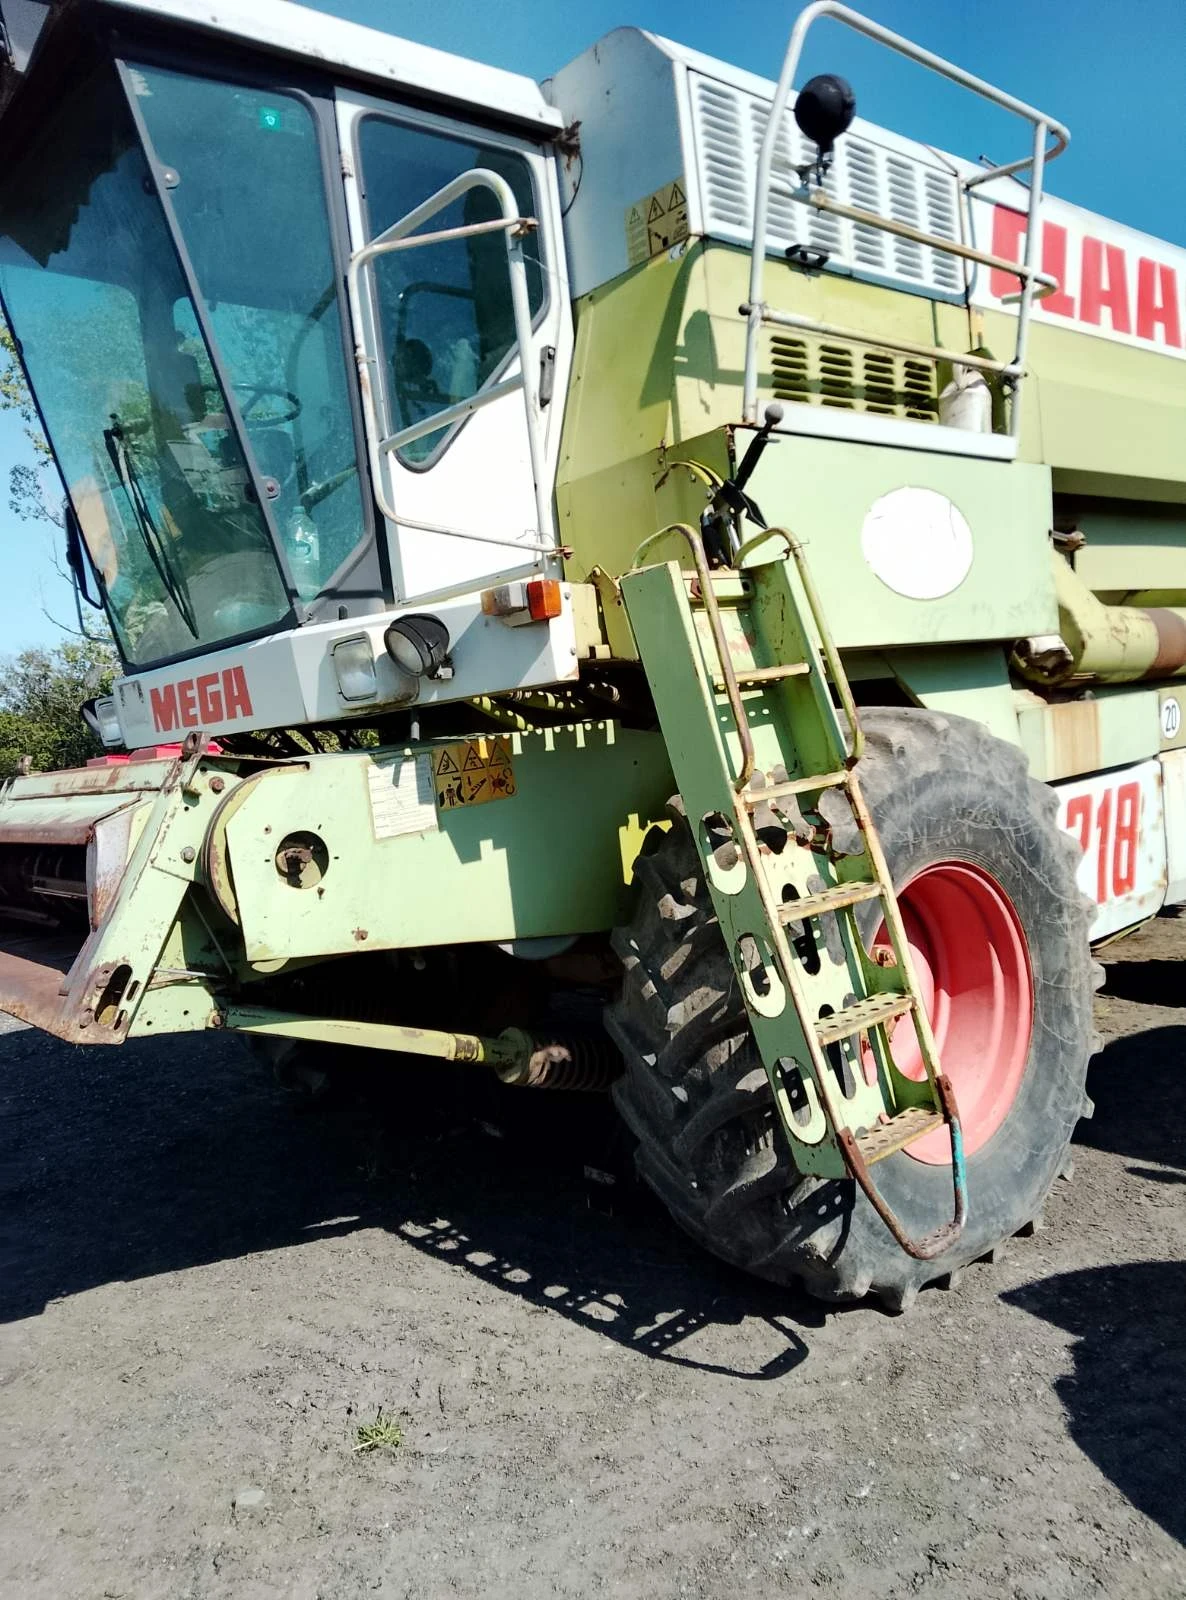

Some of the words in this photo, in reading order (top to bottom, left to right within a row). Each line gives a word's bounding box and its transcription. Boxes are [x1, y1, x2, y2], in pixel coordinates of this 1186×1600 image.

[990, 203, 1186, 349] CLAA
[150, 665, 253, 733] MEGA
[1165, 704, 1177, 732] 20
